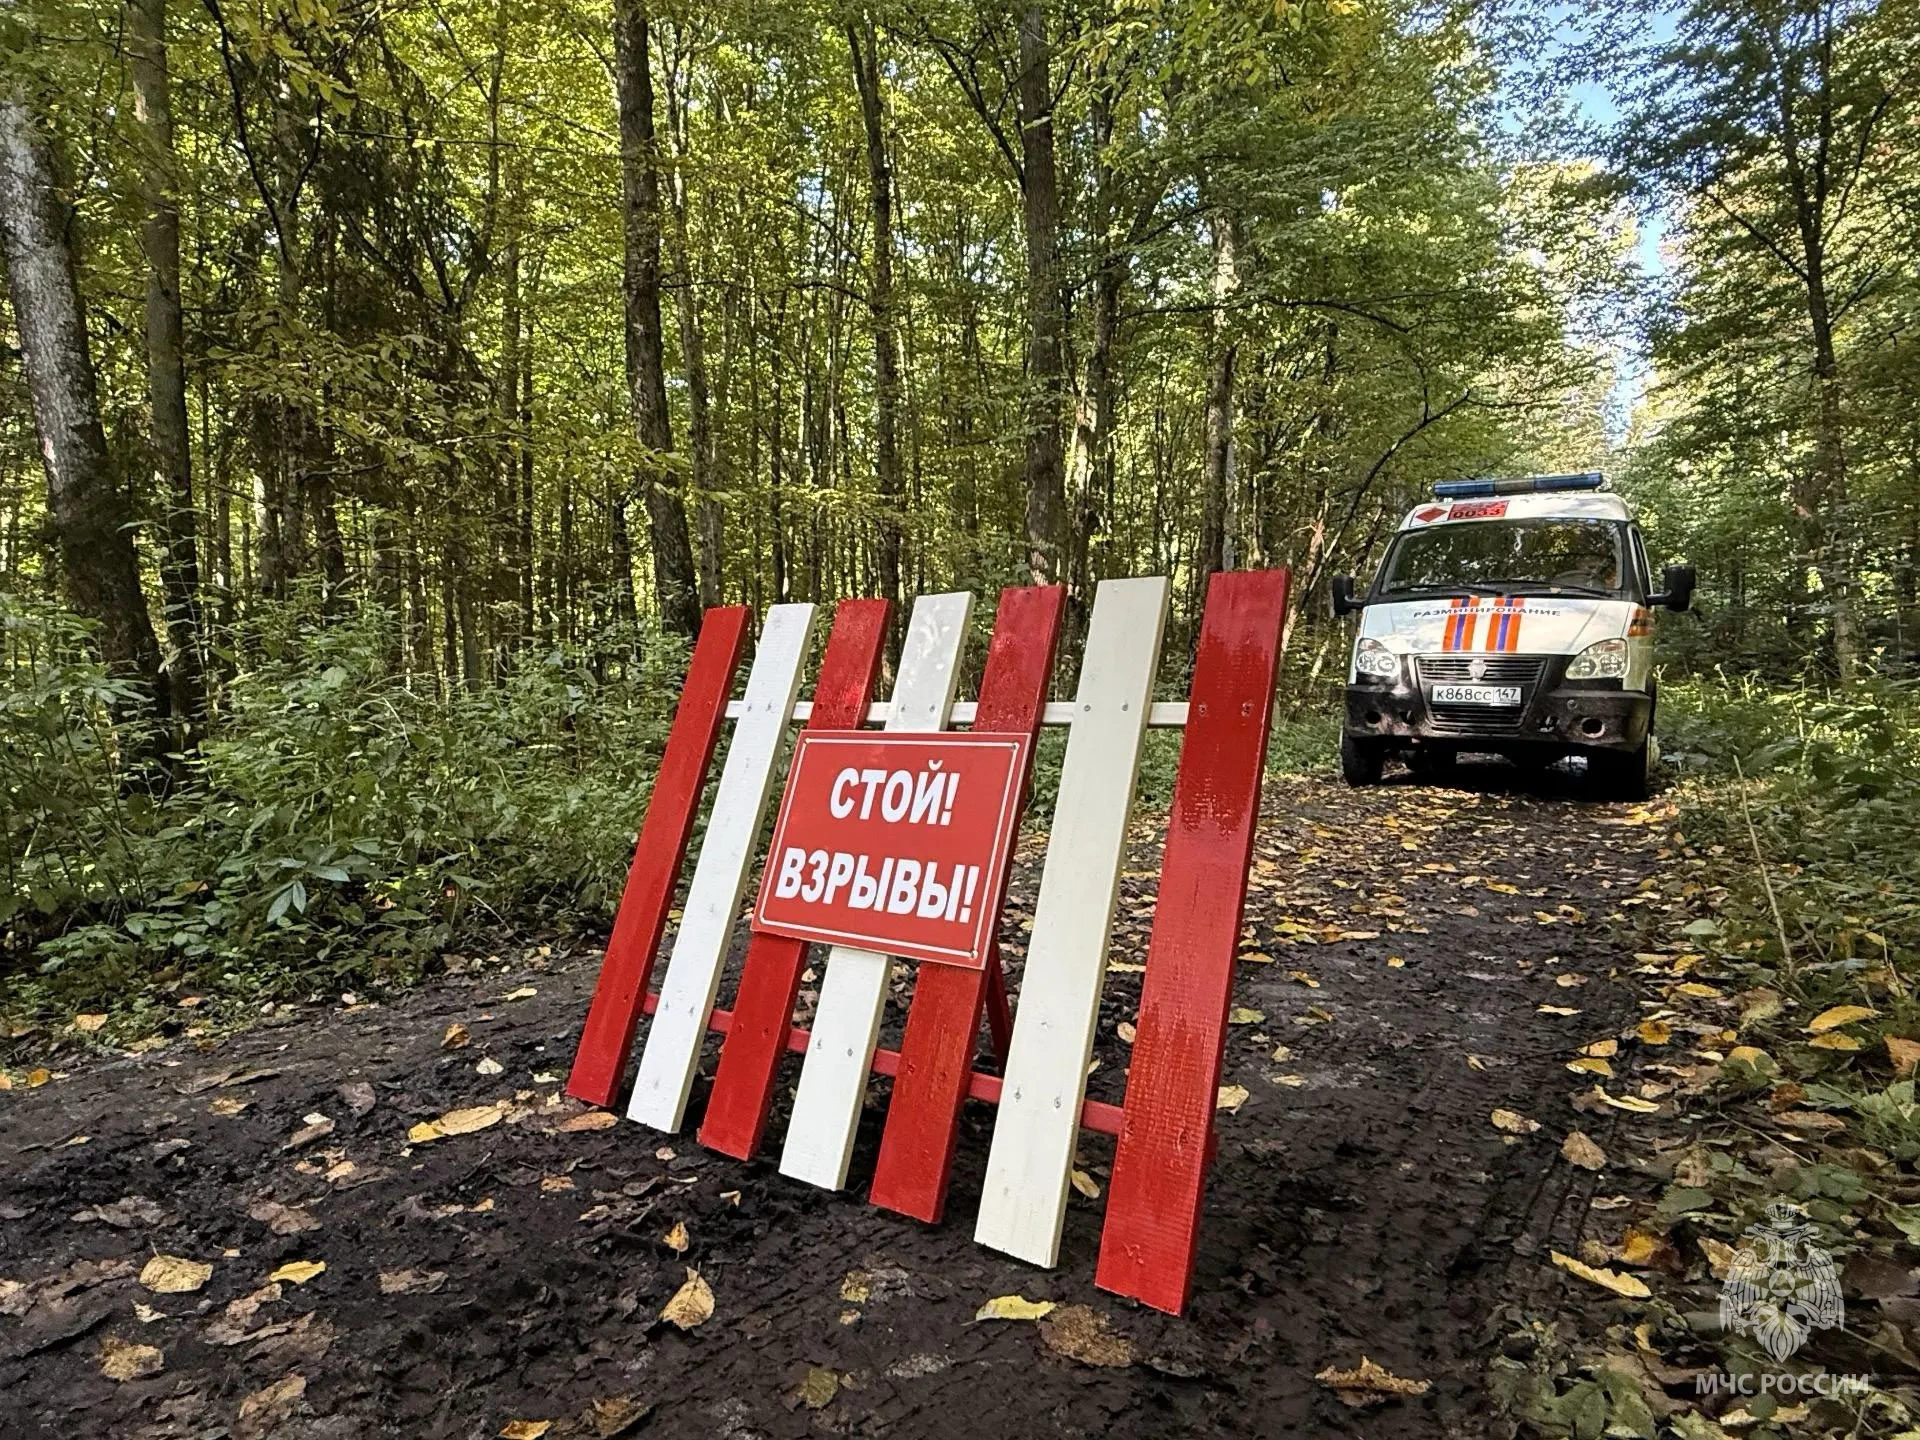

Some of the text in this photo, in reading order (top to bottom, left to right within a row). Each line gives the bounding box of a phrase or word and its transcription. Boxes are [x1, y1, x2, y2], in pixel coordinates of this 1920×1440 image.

[1413, 607, 1561, 618] РАЗМИНИРОВАНИЕ
[1495, 688, 1517, 699] 147
[829, 759, 960, 826] СТОЙ!
[775, 847, 980, 924] ВЗРЫВЫ!
